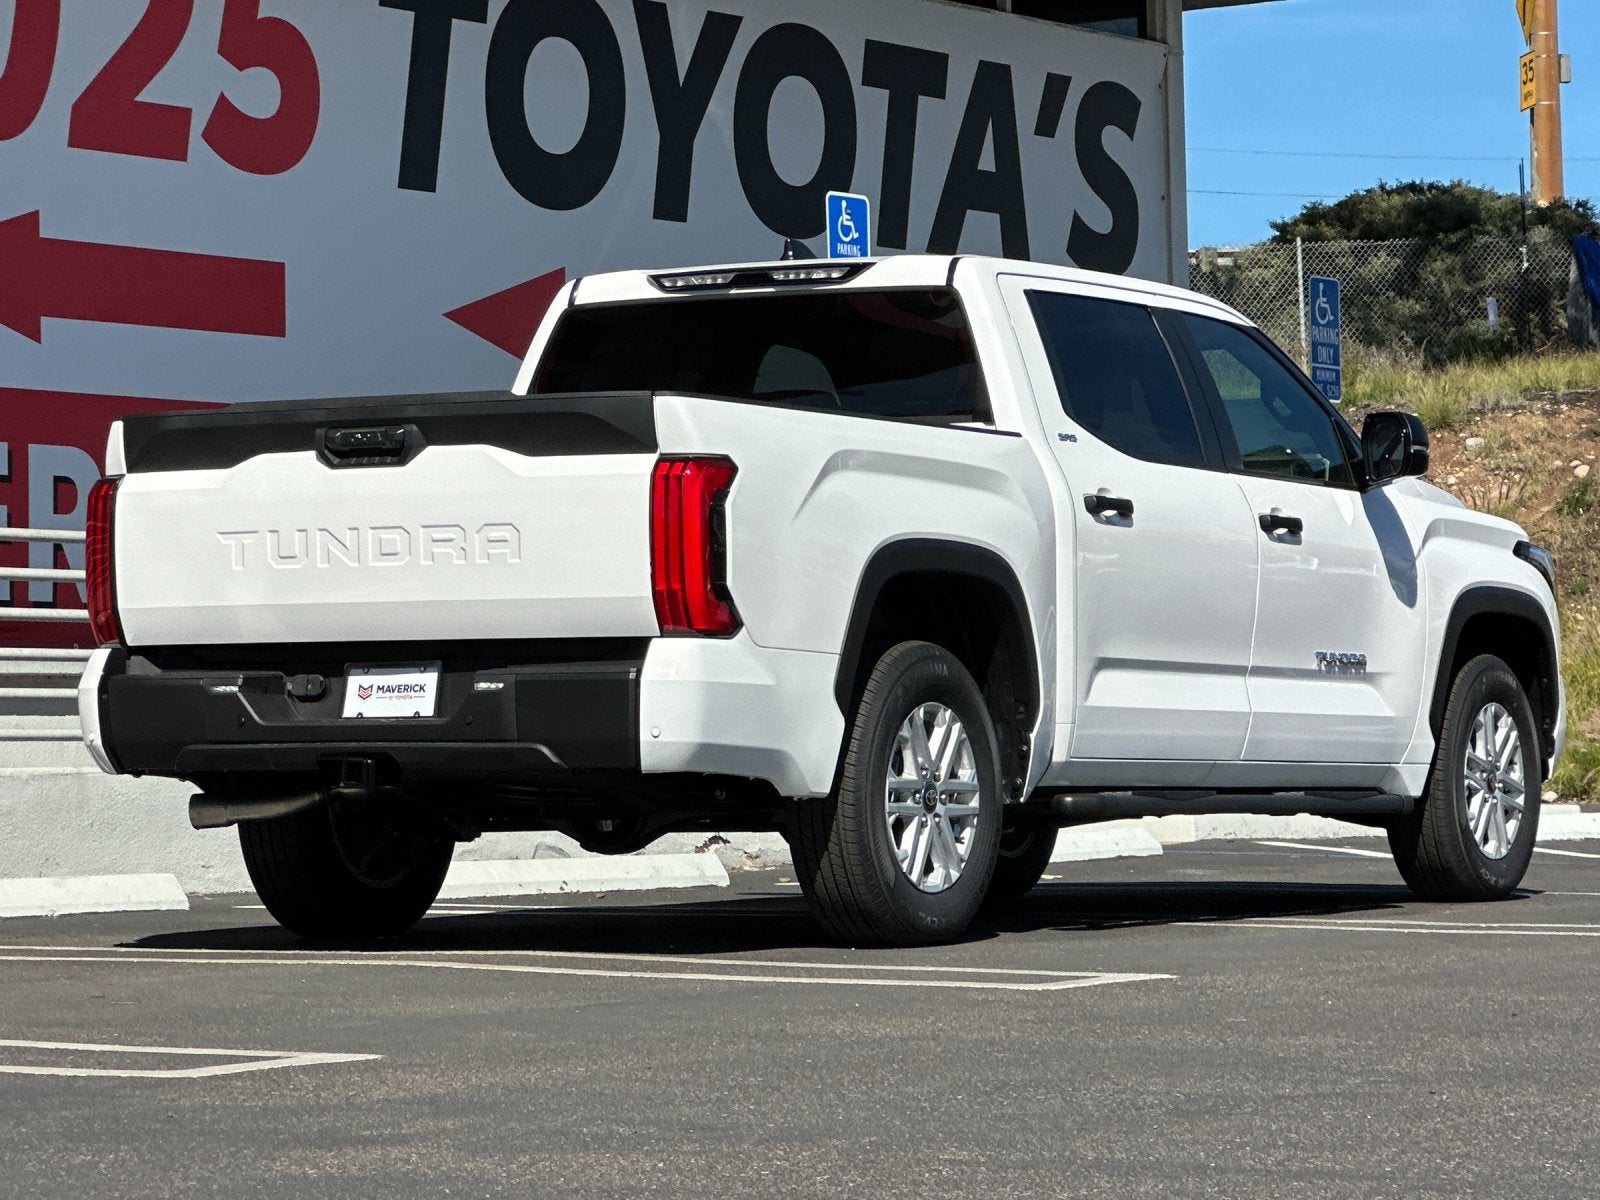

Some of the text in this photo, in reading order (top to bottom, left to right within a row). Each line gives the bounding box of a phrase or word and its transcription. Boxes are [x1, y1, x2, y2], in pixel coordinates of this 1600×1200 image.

[1523, 58, 1535, 86] 35
[378, 0, 1142, 275] TOYOTA'S
[837, 242, 861, 257] PARKING
[1312, 326, 1339, 345] PARKING
[1318, 346, 1334, 364] ONLY
[216, 522, 521, 570] TUNDRA
[376, 684, 426, 694] MAVERICK
